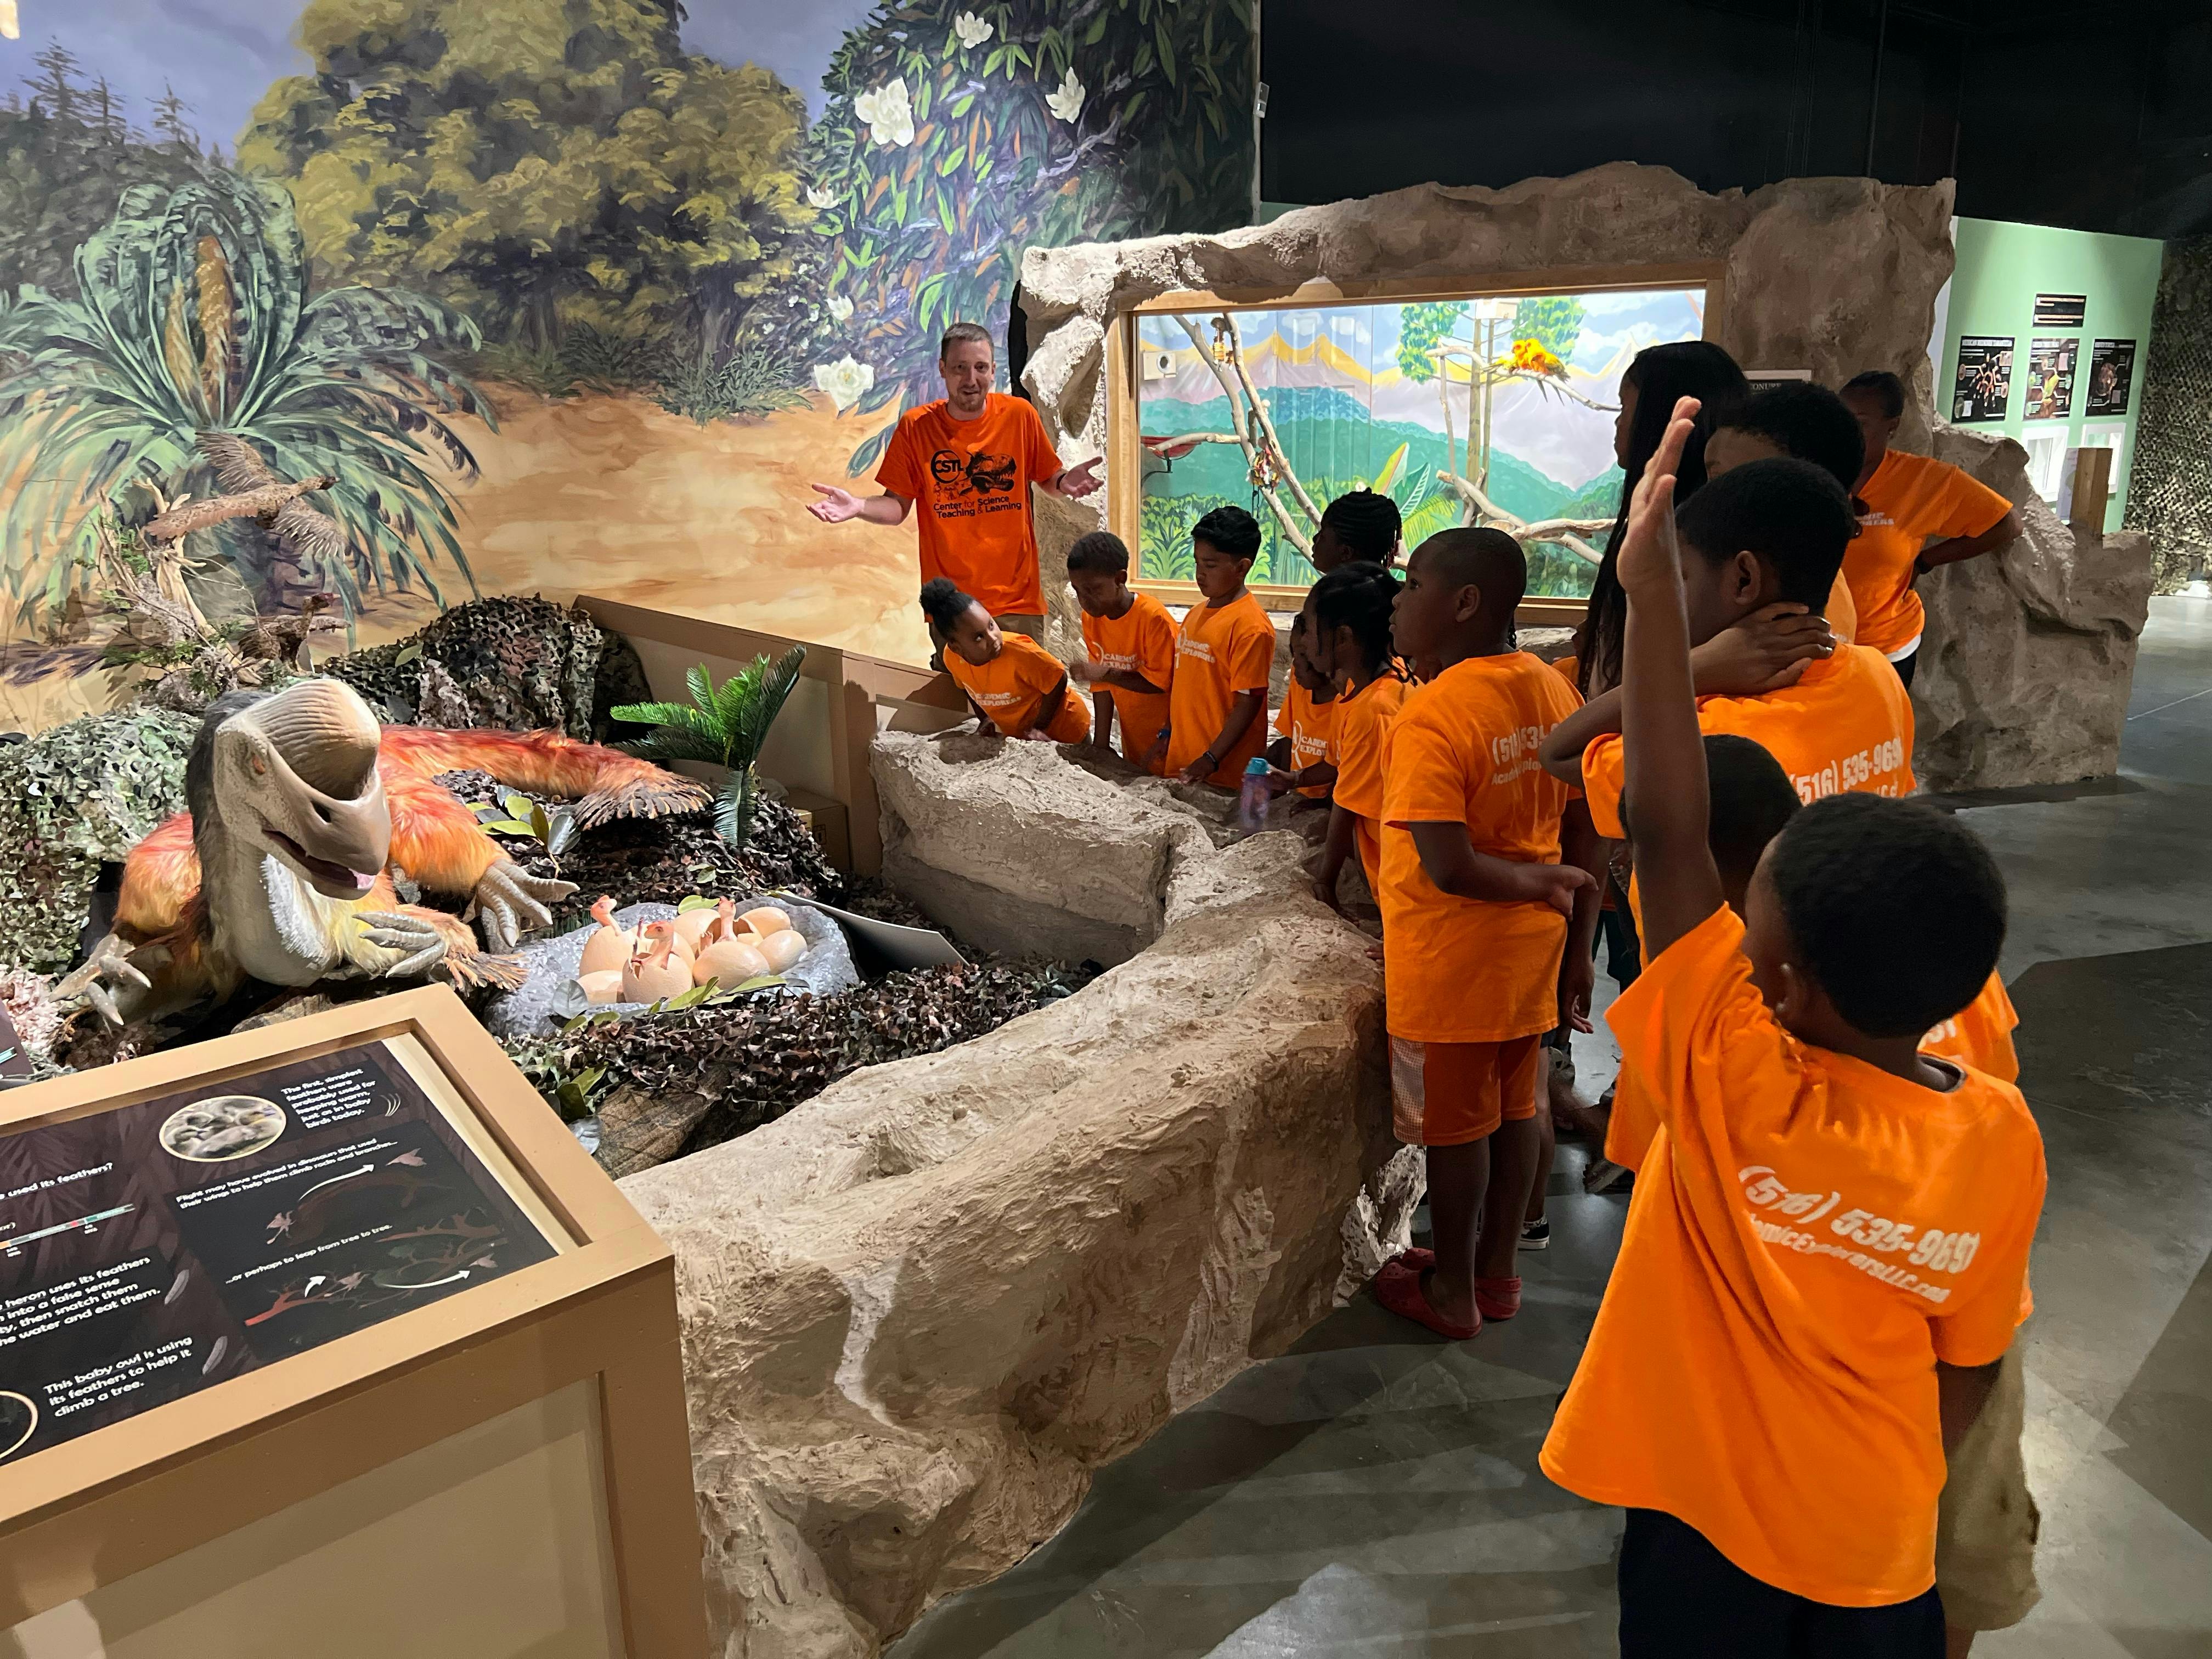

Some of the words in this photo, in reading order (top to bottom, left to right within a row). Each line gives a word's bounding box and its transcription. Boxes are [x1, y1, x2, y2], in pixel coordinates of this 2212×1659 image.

[934, 459, 964, 473] CSTL
[933, 502, 962, 511] Center
[964, 500, 975, 508] for
[977, 495, 1010, 506] Science
[936, 507, 975, 518] Teaching
[985, 502, 1022, 513] Learning
[281, 1086, 301, 1094] The
[302, 1080, 324, 1090] first,
[325, 1069, 363, 1083] simplest
[286, 1087, 326, 1102] feathers
[328, 1080, 353, 1090] were
[291, 1092, 336, 1109] probably
[338, 1084, 361, 1095] used
[362, 1080, 376, 1088] for
[296, 1100, 337, 1115] keeping
[338, 1091, 370, 1102] warm,
[301, 1113, 320, 1122] just
[334, 1104, 344, 1113] in
[344, 1098, 371, 1109] baby
[306, 1117, 331, 1128] birds
[332, 1109, 365, 1121] today.
[8, 1183, 38, 1197] used
[57, 1163, 112, 1183] feathers?
[176, 1190, 204, 1203] Flight
[205, 1184, 226, 1194] may
[227, 1177, 250, 1187] have
[252, 1165, 286, 1180] evolved
[298, 1152, 337, 1166] dinosaurs
[337, 1145, 356, 1154] that
[357, 1138, 377, 1148] used
[180, 1199, 201, 1209] their
[204, 1191, 230, 1201] wings
[242, 1181, 263, 1190] help
[263, 1173, 288, 1183] them
[289, 1166, 313, 1176] climb
[314, 1159, 336, 1169] rocks
[337, 1152, 354, 1161] and
[354, 1142, 398, 1155] branches...
[225, 1274, 242, 1284] ...or
[244, 1261, 283, 1278] perhaps
[295, 1250, 317, 1259] leap
[318, 1242, 340, 1252] from
[341, 1235, 359, 1244] tree
[371, 1224, 393, 1233] tree.
[5, 1290, 47, 1308] heron
[49, 1281, 77, 1294] uses
[78, 1276, 95, 1284] its
[96, 1257, 150, 1278] feathers
[7, 1306, 35, 1319] into
[51, 1290, 82, 1305] false
[85, 1278, 120, 1294] sense
[19, 1312, 52, 1327] then
[55, 1296, 99, 1315] snatch
[101, 1283, 138, 1299] them
[19, 1321, 60, 1339] water
[64, 1309, 92, 1324] and
[94, 1301, 119, 1313] eat
[120, 1289, 161, 1305] them.
[43, 1380, 73, 1395] This
[75, 1365, 112, 1384] baby
[116, 1353, 142, 1368] owl
[143, 1351, 154, 1359] is
[157, 1337, 192, 1354] using
[49, 1396, 66, 1406] its
[68, 1374, 126, 1398] feathers
[128, 1367, 144, 1376] to
[145, 1354, 178, 1370] help
[180, 1349, 192, 1358] it
[55, 1398, 95, 1417] climb
[98, 1393, 109, 1401] a
[110, 1381, 145, 1397] tree.
